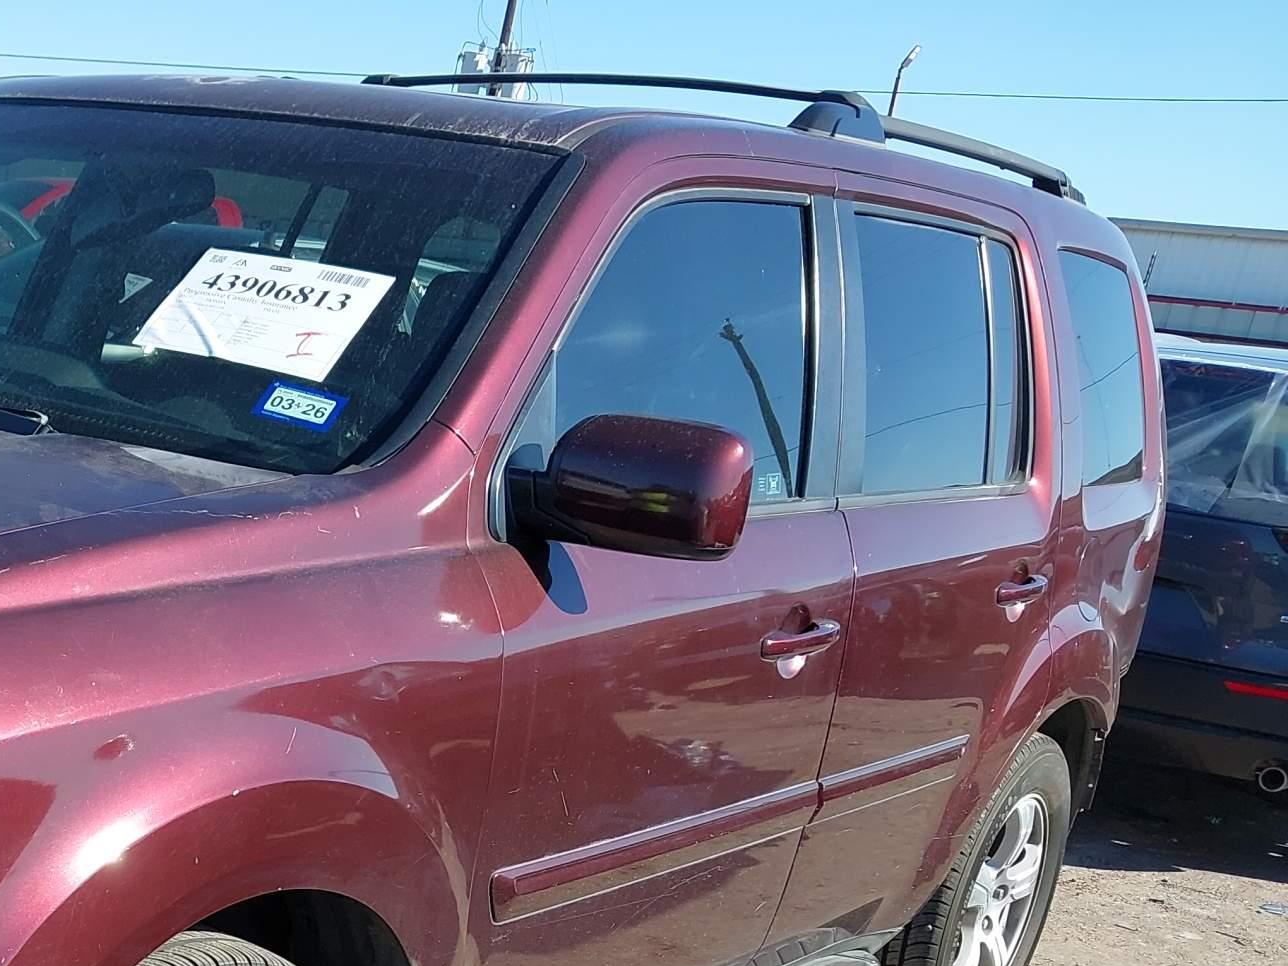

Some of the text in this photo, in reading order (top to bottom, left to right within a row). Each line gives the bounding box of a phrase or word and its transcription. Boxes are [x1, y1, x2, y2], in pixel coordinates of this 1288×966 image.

[201, 271, 352, 312] 43906813
[270, 395, 295, 410] 03
[301, 402, 328, 419] 26
